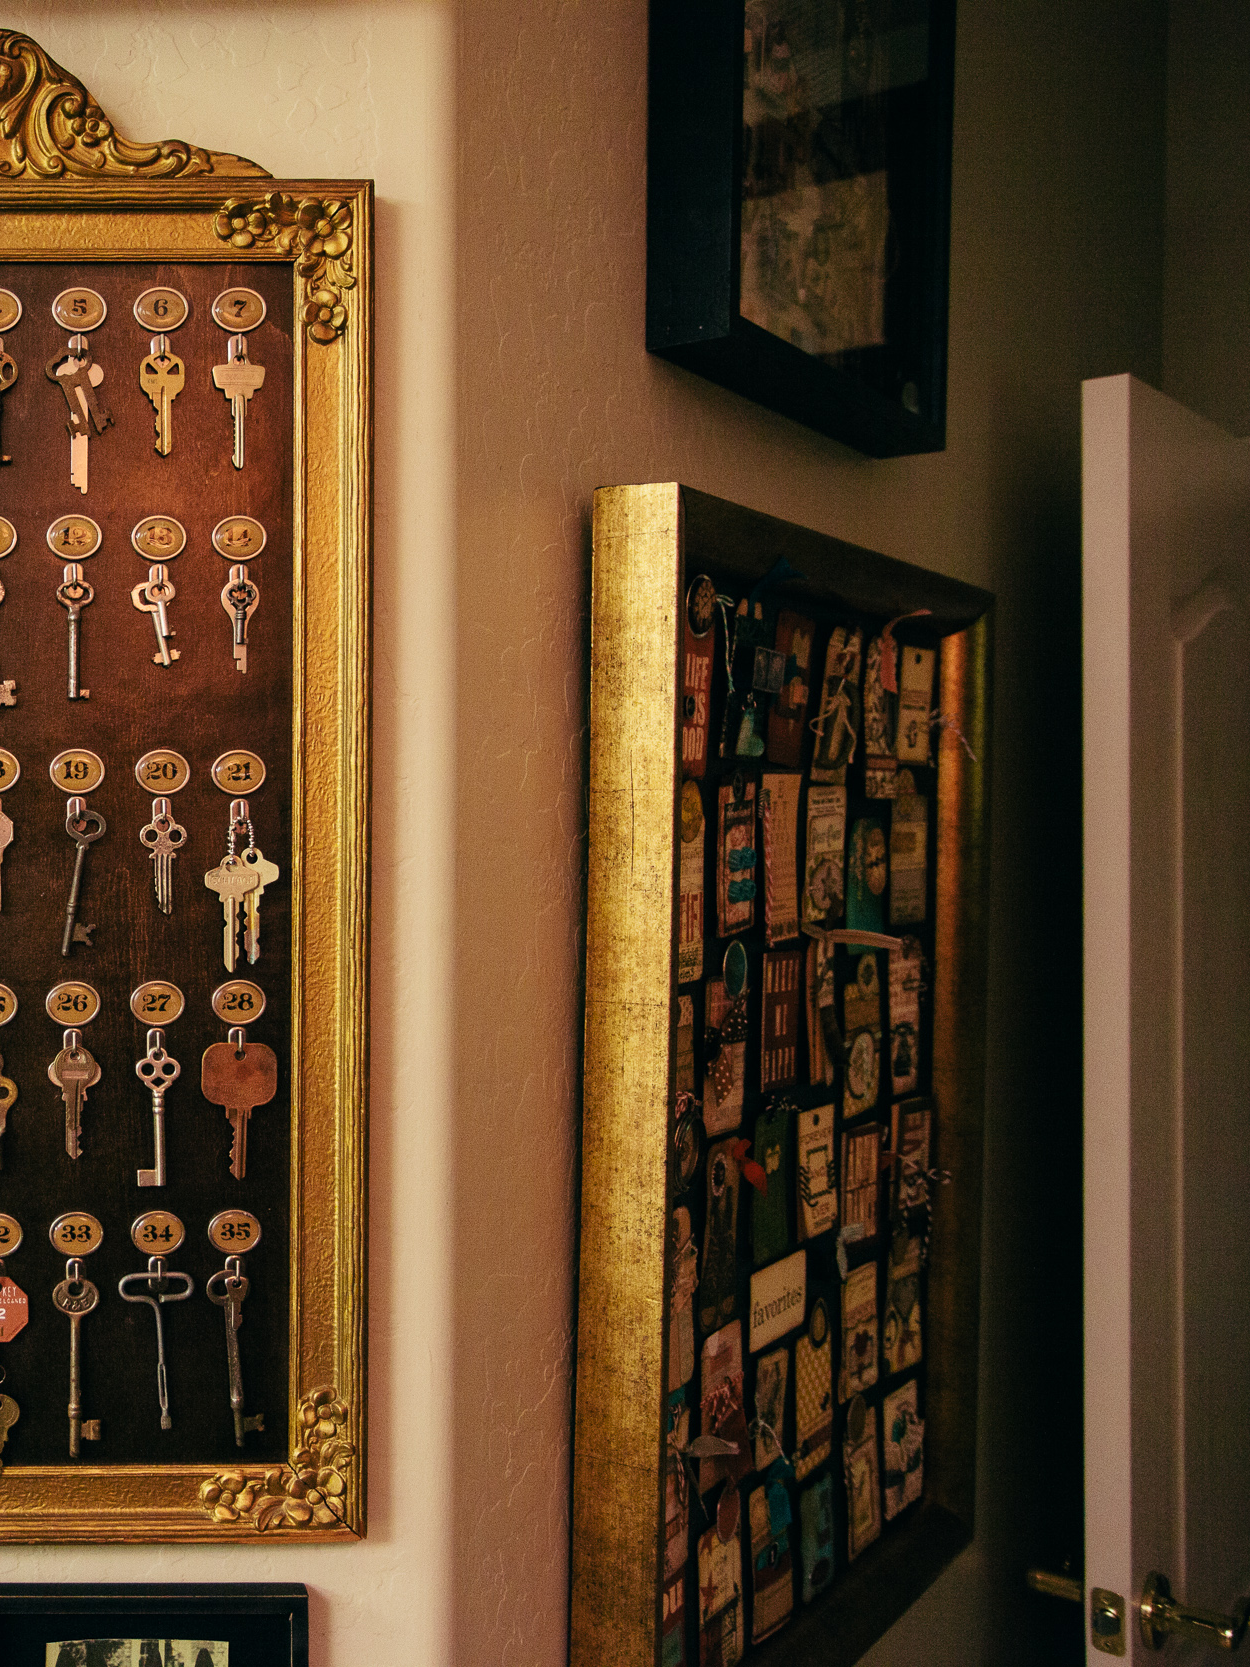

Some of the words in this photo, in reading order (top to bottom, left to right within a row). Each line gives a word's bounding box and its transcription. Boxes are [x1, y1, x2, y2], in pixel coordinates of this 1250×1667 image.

[72, 299, 86, 315] 5
[154, 299, 168, 316] 6
[234, 300, 247, 317] 7
[685, 653, 709, 690] LIFE
[64, 761, 88, 779] 19
[147, 762, 177, 780] 20
[228, 762, 252, 781] 21
[57, 993, 87, 1012] 26
[143, 994, 170, 1012] 27
[222, 993, 253, 1010] 28
[62, 1225, 92, 1242] 33
[143, 1225, 173, 1242] 34
[221, 1223, 250, 1240] 35
[2, 1286, 17, 1297] KEY
[753, 1286, 802, 1328] favorites
